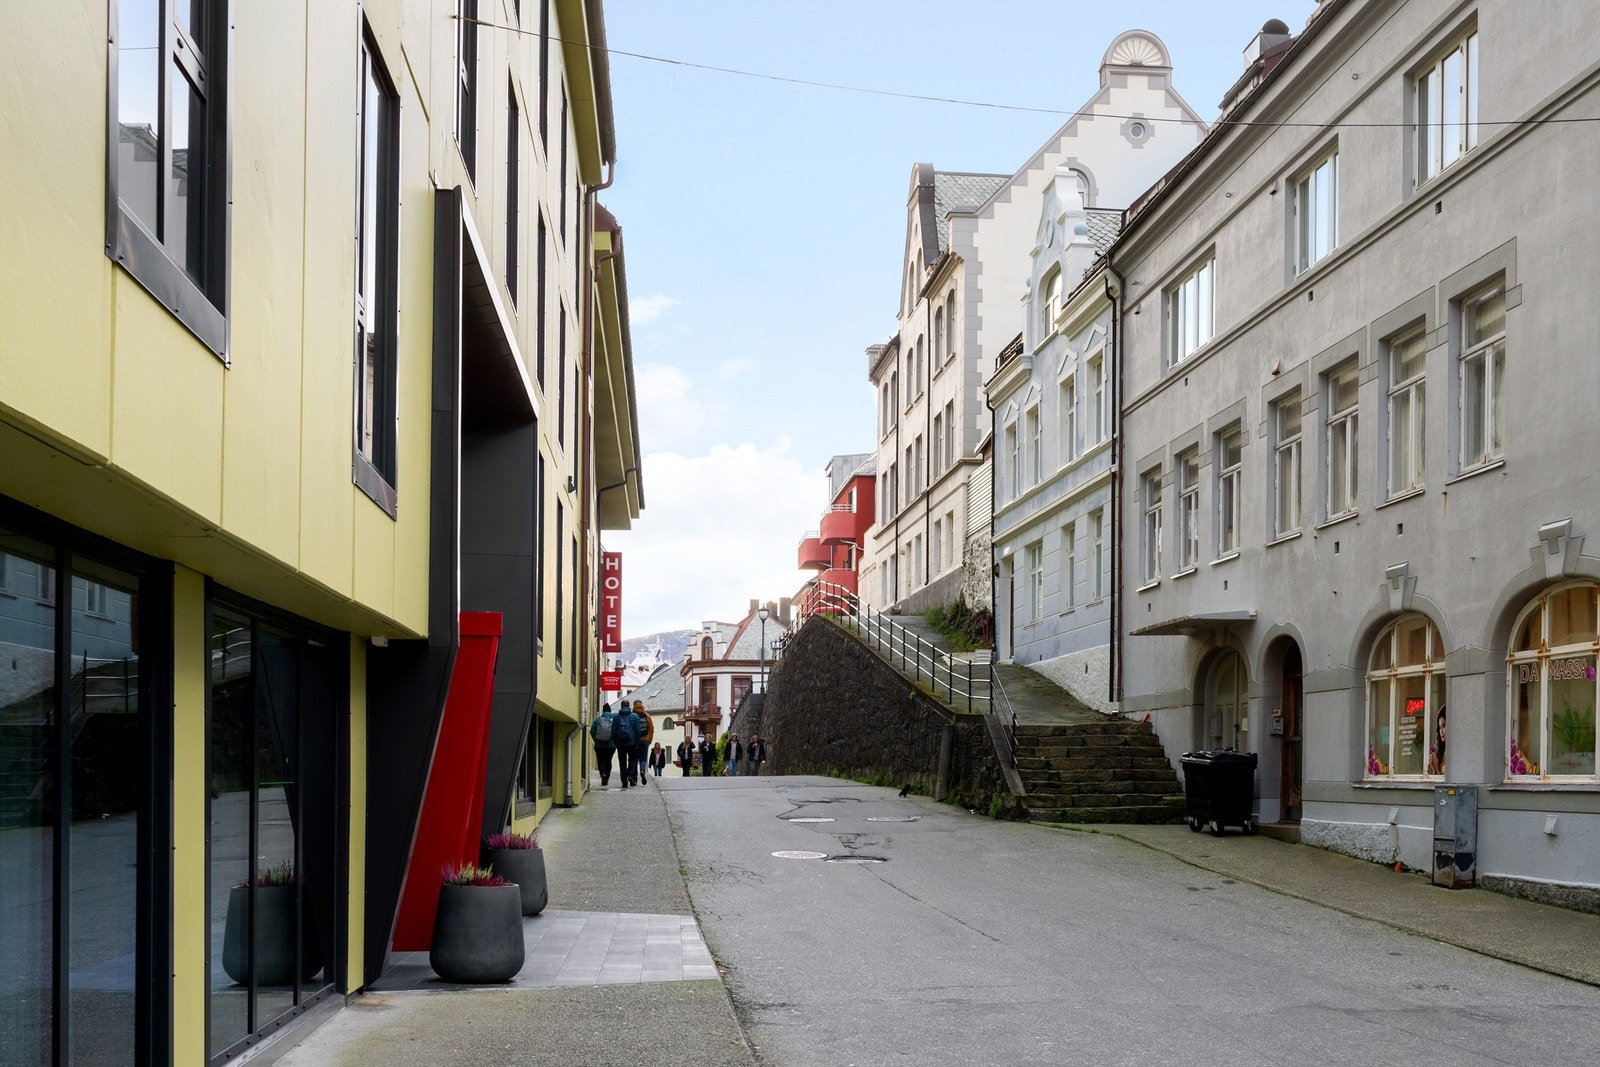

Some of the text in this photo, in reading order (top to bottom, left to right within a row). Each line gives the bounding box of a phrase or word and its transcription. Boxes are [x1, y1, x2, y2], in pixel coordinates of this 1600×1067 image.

[605, 557, 619, 647] HOTEL
[1519, 662, 1540, 684] DA
[1407, 700, 1424, 715] Open
